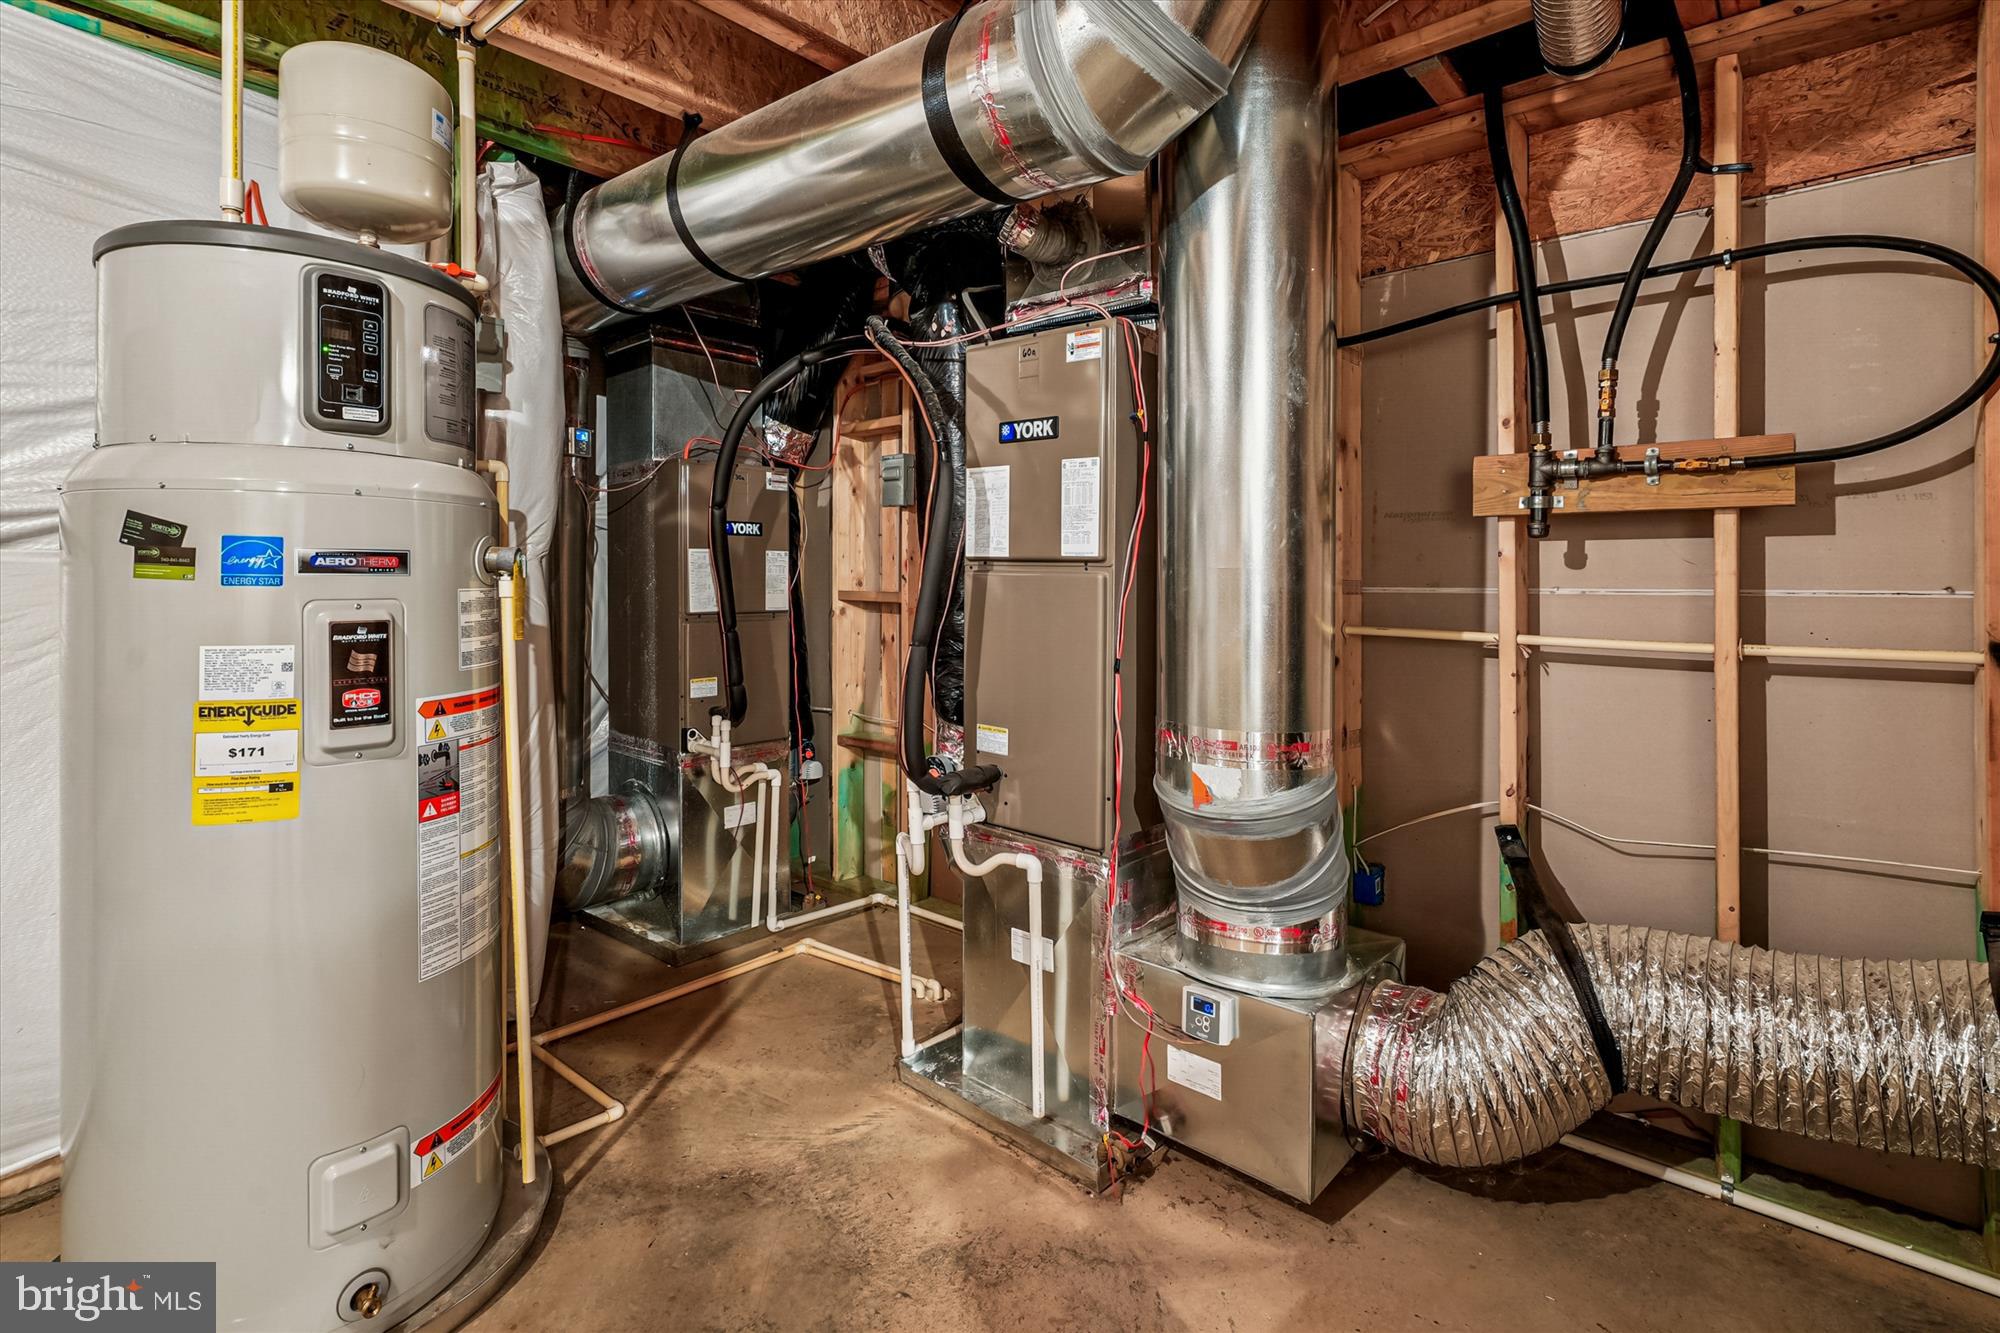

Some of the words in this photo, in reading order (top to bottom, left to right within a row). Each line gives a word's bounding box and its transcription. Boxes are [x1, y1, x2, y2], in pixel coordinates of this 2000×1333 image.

[345, 26, 401, 53] JOIST
[323, 288, 359, 299] BRADFORD
[360, 295, 379, 304] WHITE
[1014, 419, 1054, 439] YORK
[731, 523, 760, 534] YORK
[223, 577, 256, 585] ENERGY
[258, 577, 280, 585] STAR
[345, 692, 379, 700] PHCC
[228, 747, 264, 758] $171
